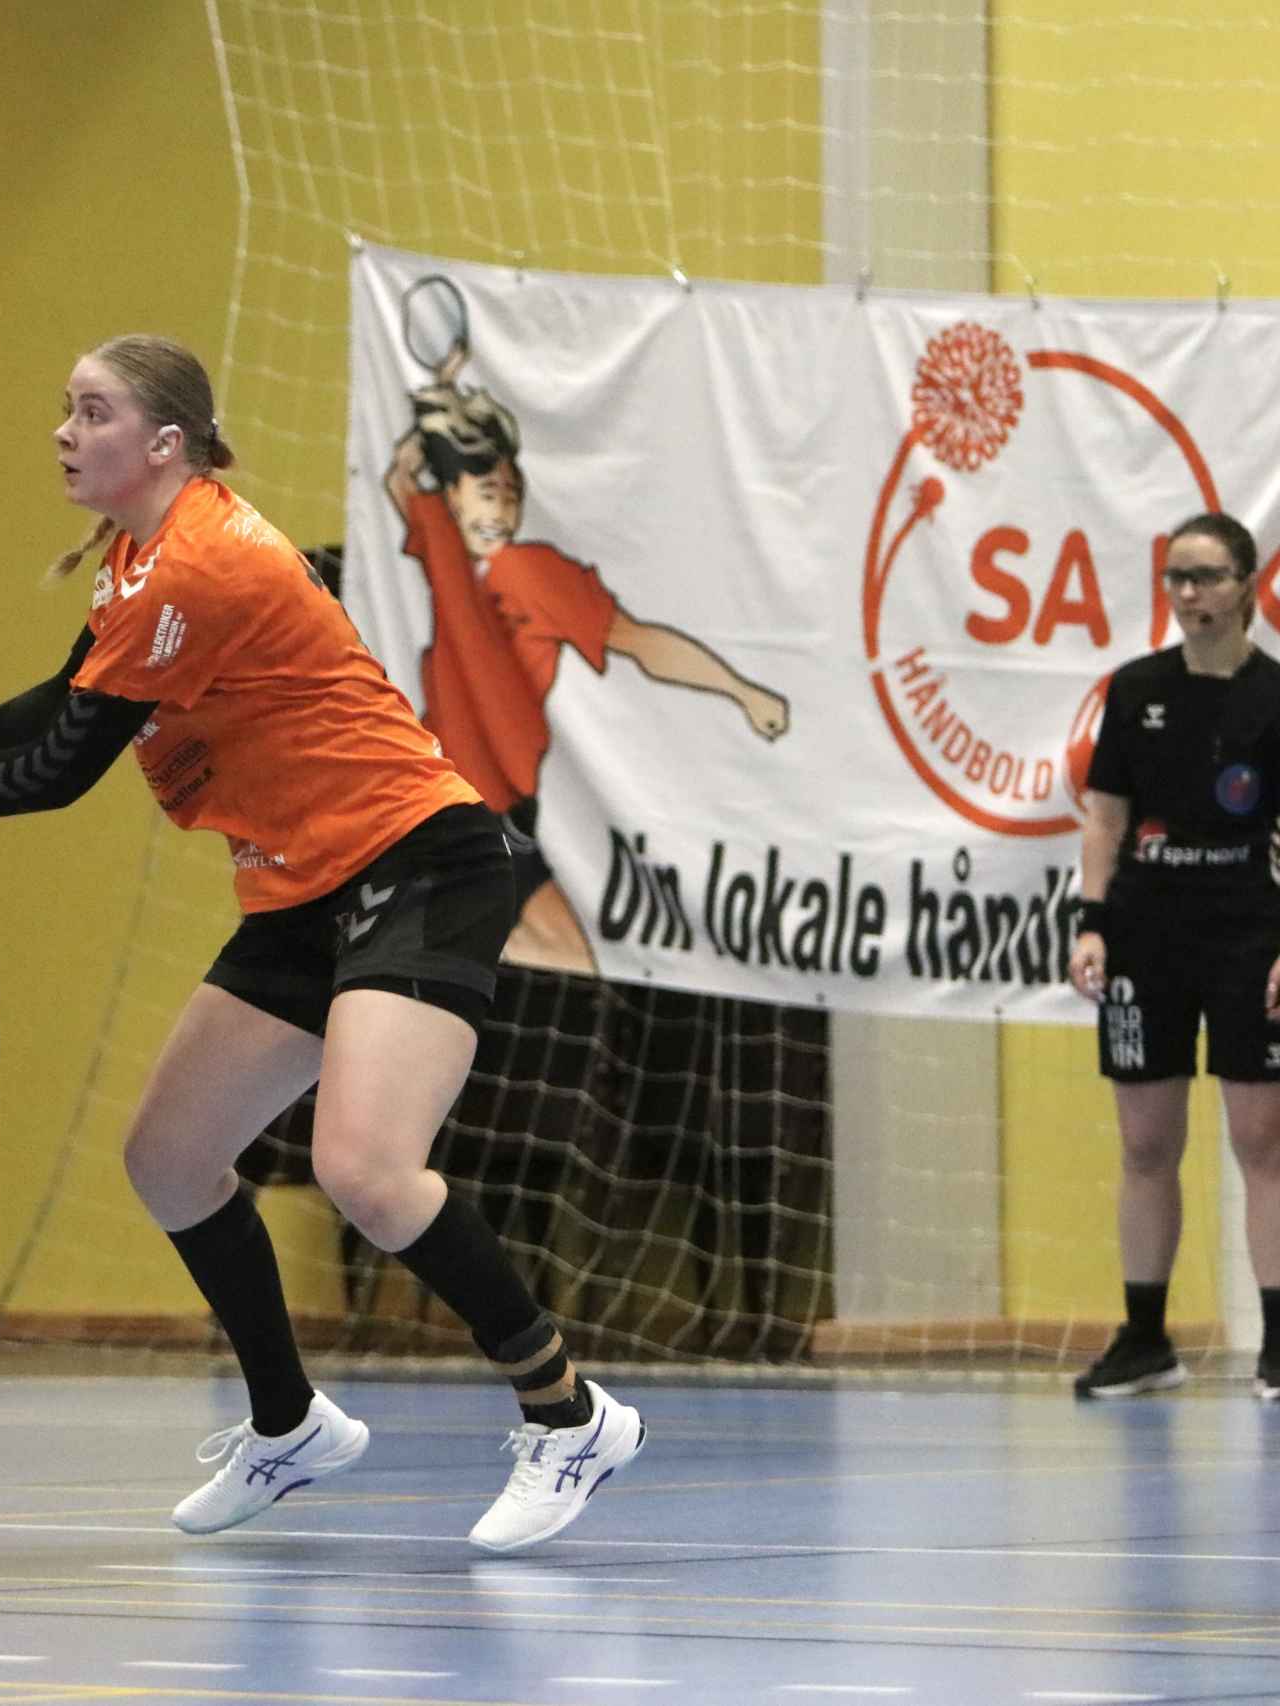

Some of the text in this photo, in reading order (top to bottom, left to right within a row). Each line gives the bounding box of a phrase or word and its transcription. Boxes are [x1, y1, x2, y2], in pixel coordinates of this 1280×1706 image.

[964, 526, 1112, 648] SA
[895, 645, 1054, 802] HÅNDBOLD
[599, 825, 694, 952] Din
[704, 840, 886, 979] lokale
